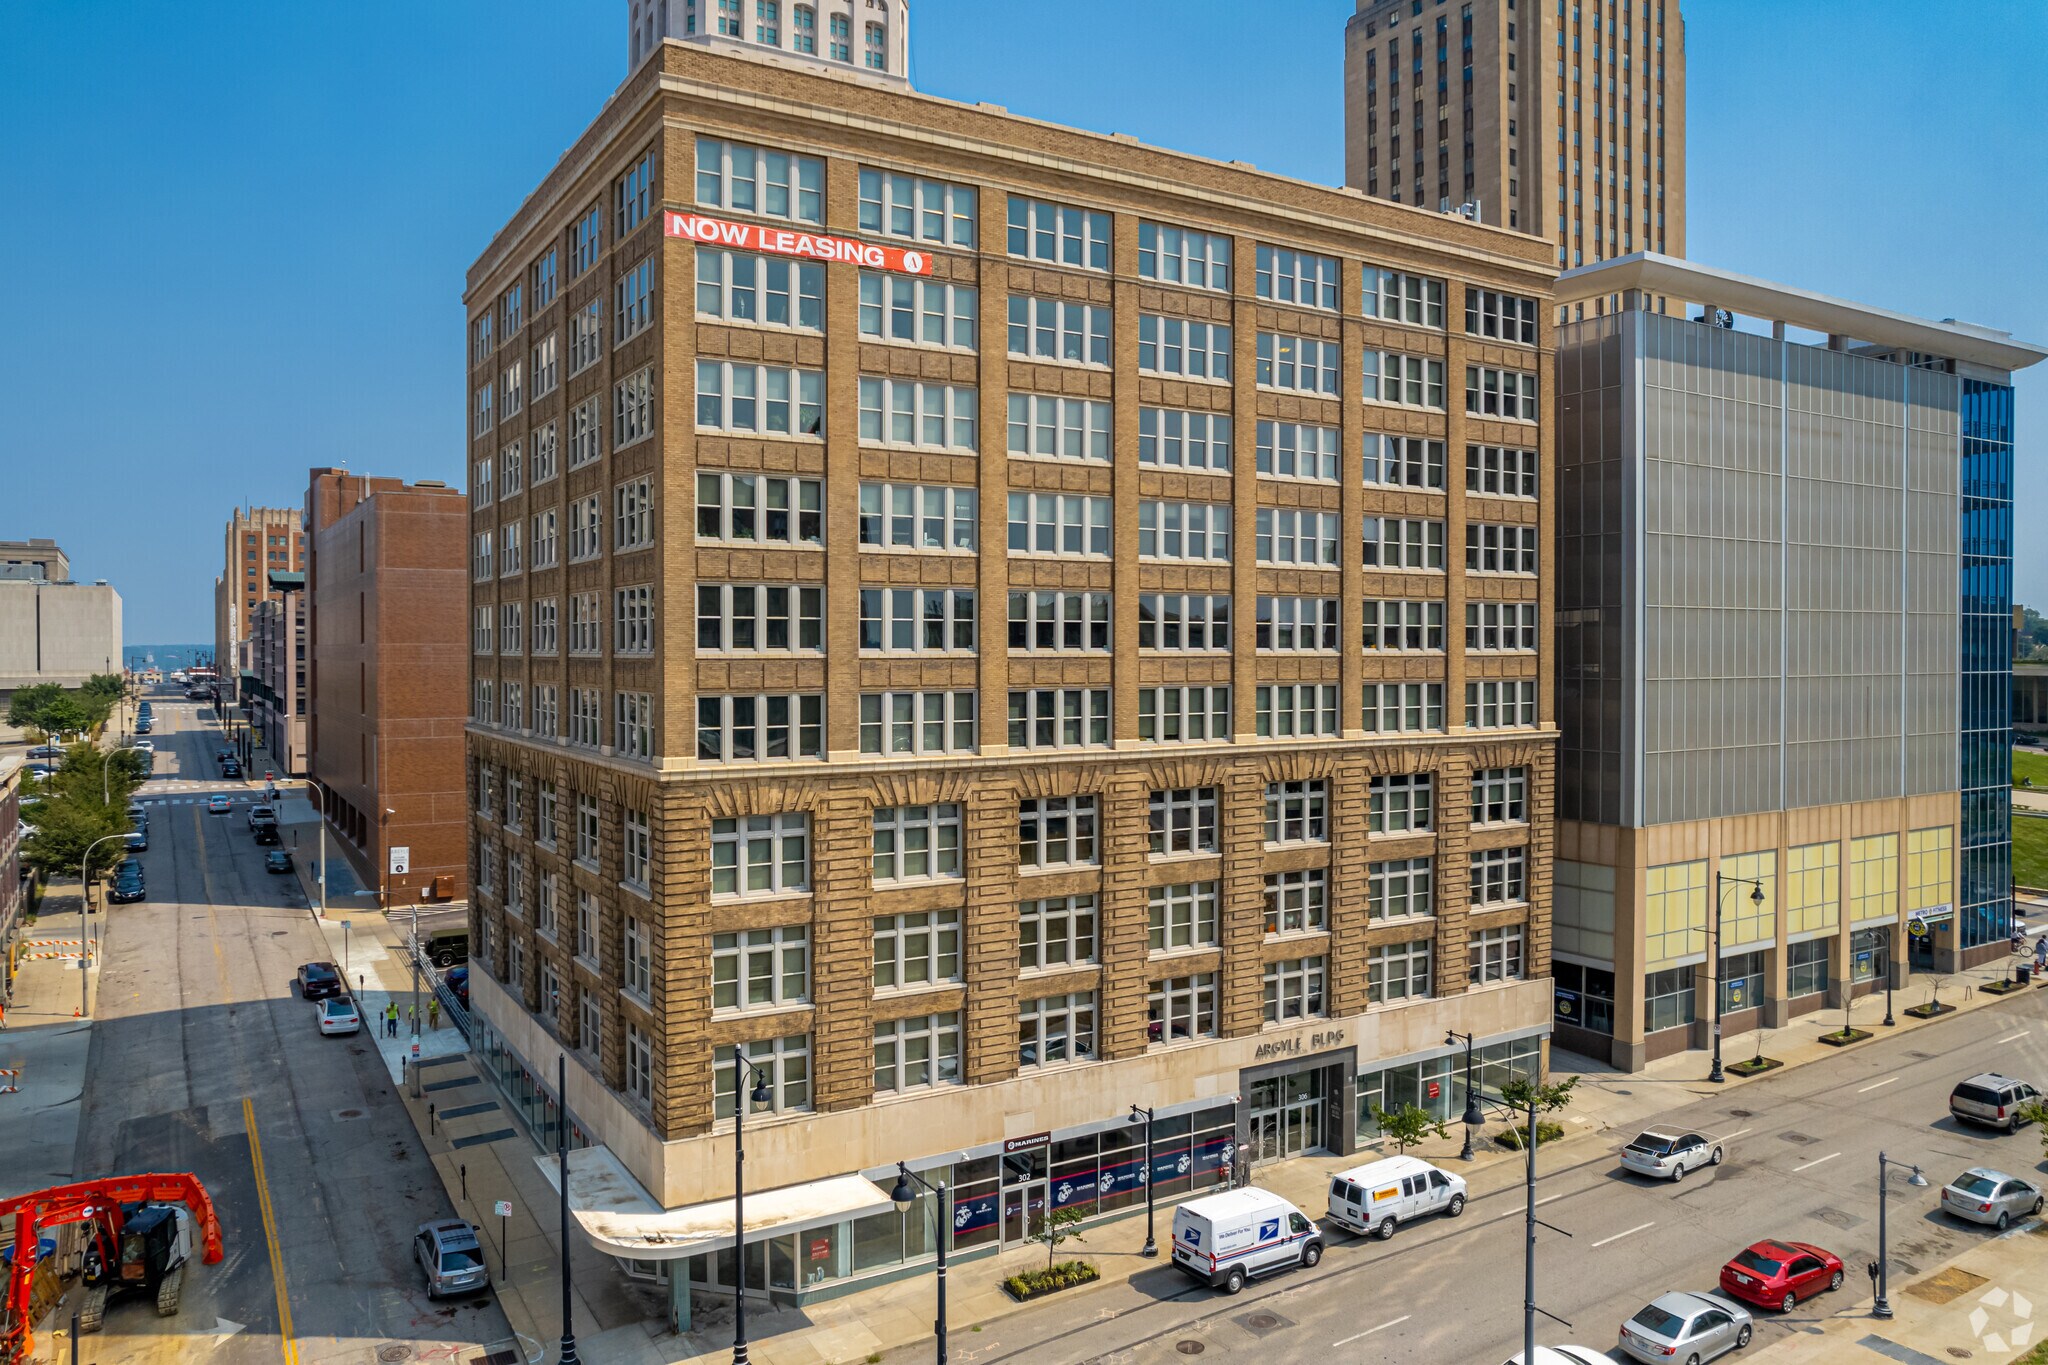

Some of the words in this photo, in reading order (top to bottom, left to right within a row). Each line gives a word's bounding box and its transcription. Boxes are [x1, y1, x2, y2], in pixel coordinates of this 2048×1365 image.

[673, 215, 749, 246] NOW
[759, 229, 885, 267] LEASING
[1255, 1037, 1302, 1058] ARGYLE
[1014, 1135, 1049, 1148] MARINES
[1018, 1172, 1031, 1183] 302
